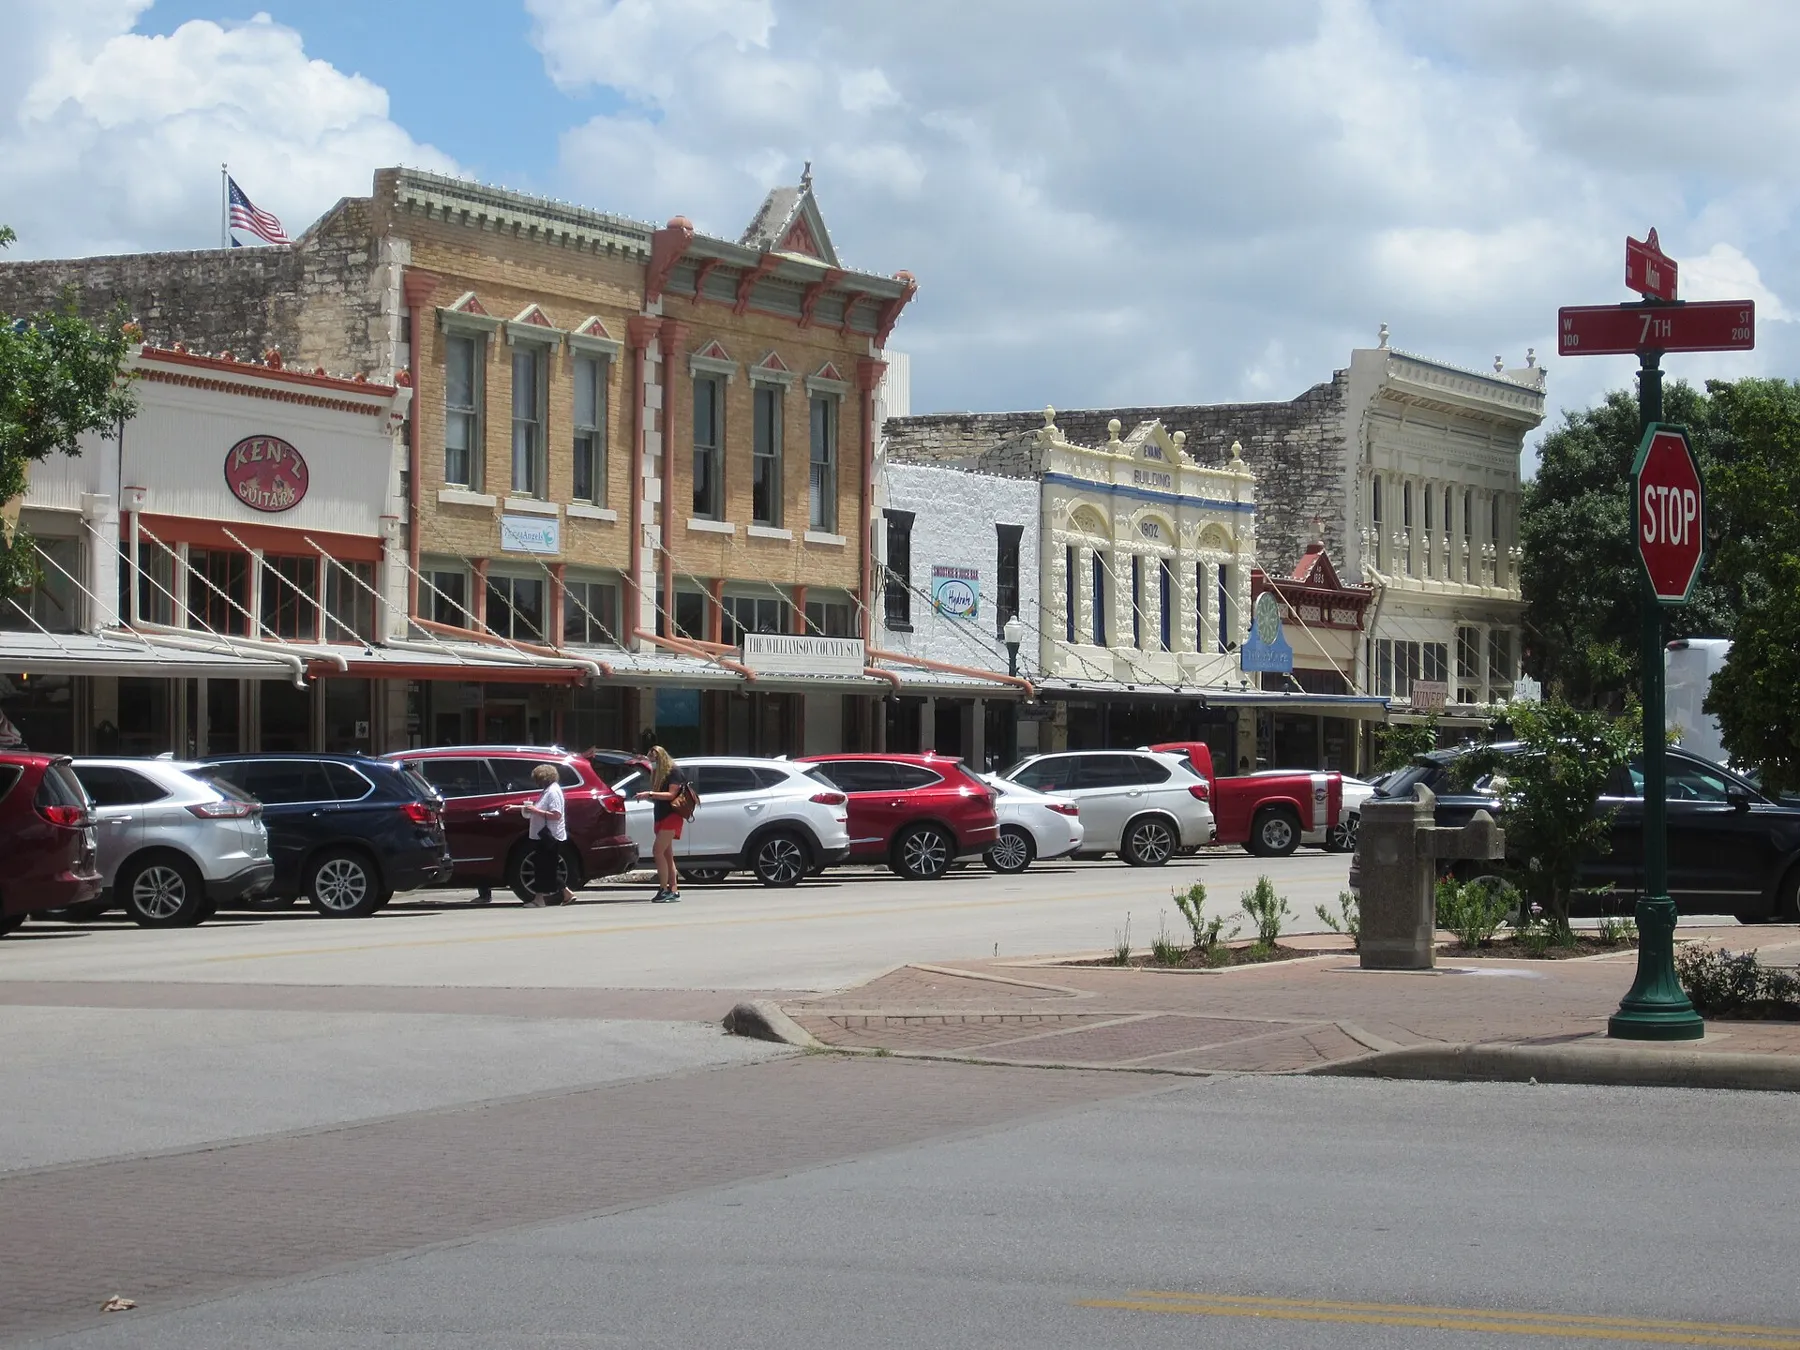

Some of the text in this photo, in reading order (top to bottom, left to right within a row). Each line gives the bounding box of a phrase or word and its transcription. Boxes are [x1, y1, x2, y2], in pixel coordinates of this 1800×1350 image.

[1645, 258, 1660, 291] Main
[1563, 318, 1573, 331] W
[1739, 311, 1750, 324] ST
[1638, 314, 1671, 344] 7TH
[1731, 327, 1750, 341] 200
[1563, 334, 1579, 347] 100
[1133, 469, 1171, 488] BUILDING
[239, 481, 295, 507] GUITARS
[1643, 484, 1697, 546] STOP
[1141, 522, 1159, 539] 1902
[749, 637, 861, 657] THE WILLIAMSON COUNTY SUN
[1413, 690, 1447, 708] WINERY
